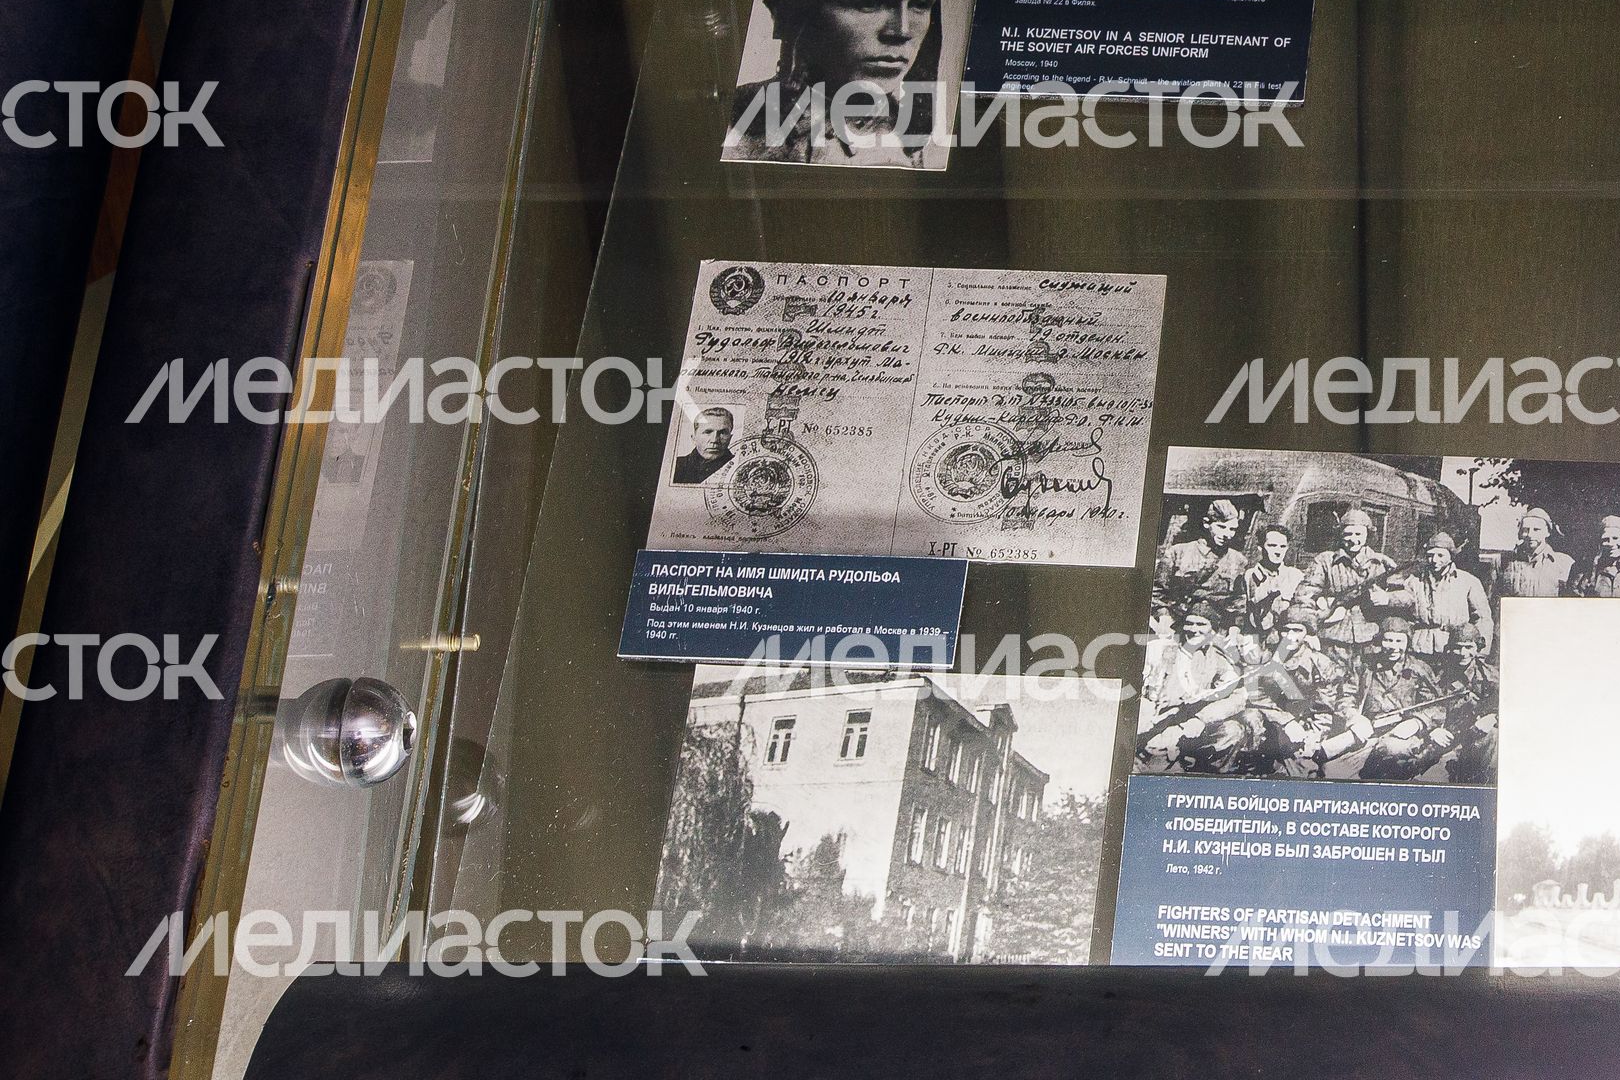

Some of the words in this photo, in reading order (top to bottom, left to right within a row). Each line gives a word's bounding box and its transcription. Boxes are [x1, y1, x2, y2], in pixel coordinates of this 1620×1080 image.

[1002, 27, 1020, 37] N.I.
[1026, 28, 1101, 40] KUZNETSOV
[1139, 32, 1184, 43] SENIOR
[1190, 34, 1269, 47] LIEUTENANT
[1274, 37, 1291, 48] OF
[1000, 41, 1024, 51] THE
[1028, 42, 1072, 53] SOVIET
[1074, 44, 1095, 54] AIR
[1099, 45, 1148, 56] FORCES
[1152, 47, 1209, 58] UNIFORM
[1005, 59, 1038, 67] Moscow,
[776, 274, 910, 289] ПАСПОРТ
[825, 425, 873, 437] 652385
[990, 547, 1038, 560] 652385
[651, 564, 713, 578] ПАСПОРТ
[715, 565, 734, 578] НА
[736, 566, 766, 579] ИМЯ
[768, 567, 825, 582] ШМИДТА
[828, 569, 900, 584] РУДОЛЬФА
[648, 583, 773, 599] ВИЛЬГЕЛЬМОВИЧА
[650, 603, 681, 614] Выдан
[696, 605, 728, 616] января
[731, 605, 750, 614] 1940
[645, 630, 667, 639] 1940
[646, 619, 665, 630] Под
[668, 621, 690, 629] этим
[692, 622, 727, 631] именем
[729, 622, 749, 630] Н.И.
[751, 623, 794, 633] Кузнецов
[796, 625, 814, 633] жил
[825, 624, 863, 635] работал
[918, 627, 941, 637] 1939
[1167, 795, 1224, 812] ГРУППА
[1227, 795, 1289, 814] БОЙЦОВ
[1293, 799, 1418, 818] ПАРТИЗАНСКОГО
[1422, 803, 1480, 821] ОТРЯДА
[1165, 818, 1282, 837] «ПОБЕДИТЕЛИ»,
[1300, 822, 1369, 838] СОСТАВЕ
[1372, 824, 1450, 841] КОТОРОГО
[1162, 840, 1191, 854] Н.И.
[1194, 841, 1272, 859] КУЗНЕЦОВ
[1274, 843, 1309, 858] БЫЛ
[1312, 845, 1395, 862] ЗАБРОШЕН
[1412, 848, 1446, 863] ТЫЛ
[1166, 863, 1190, 876] Лето,
[1193, 864, 1214, 875] 1942
[1158, 905, 1230, 921] FIGHTERS
[1233, 907, 1254, 922] OF
[1257, 908, 1330, 926] PARTISAN
[1332, 911, 1432, 929] DETACHMENT
[1156, 924, 1237, 940] "WINNERS"
[1240, 927, 1278, 941] WITH
[1280, 928, 1327, 944] WHOM
[1330, 930, 1353, 944] N.I.
[1356, 931, 1446, 948] KUZNETSOV
[1449, 934, 1482, 950] WAS
[1154, 942, 1193, 958] SENT
[1196, 943, 1217, 959] TO
[1220, 944, 1250, 960] THE
[1252, 945, 1293, 961] REAR
